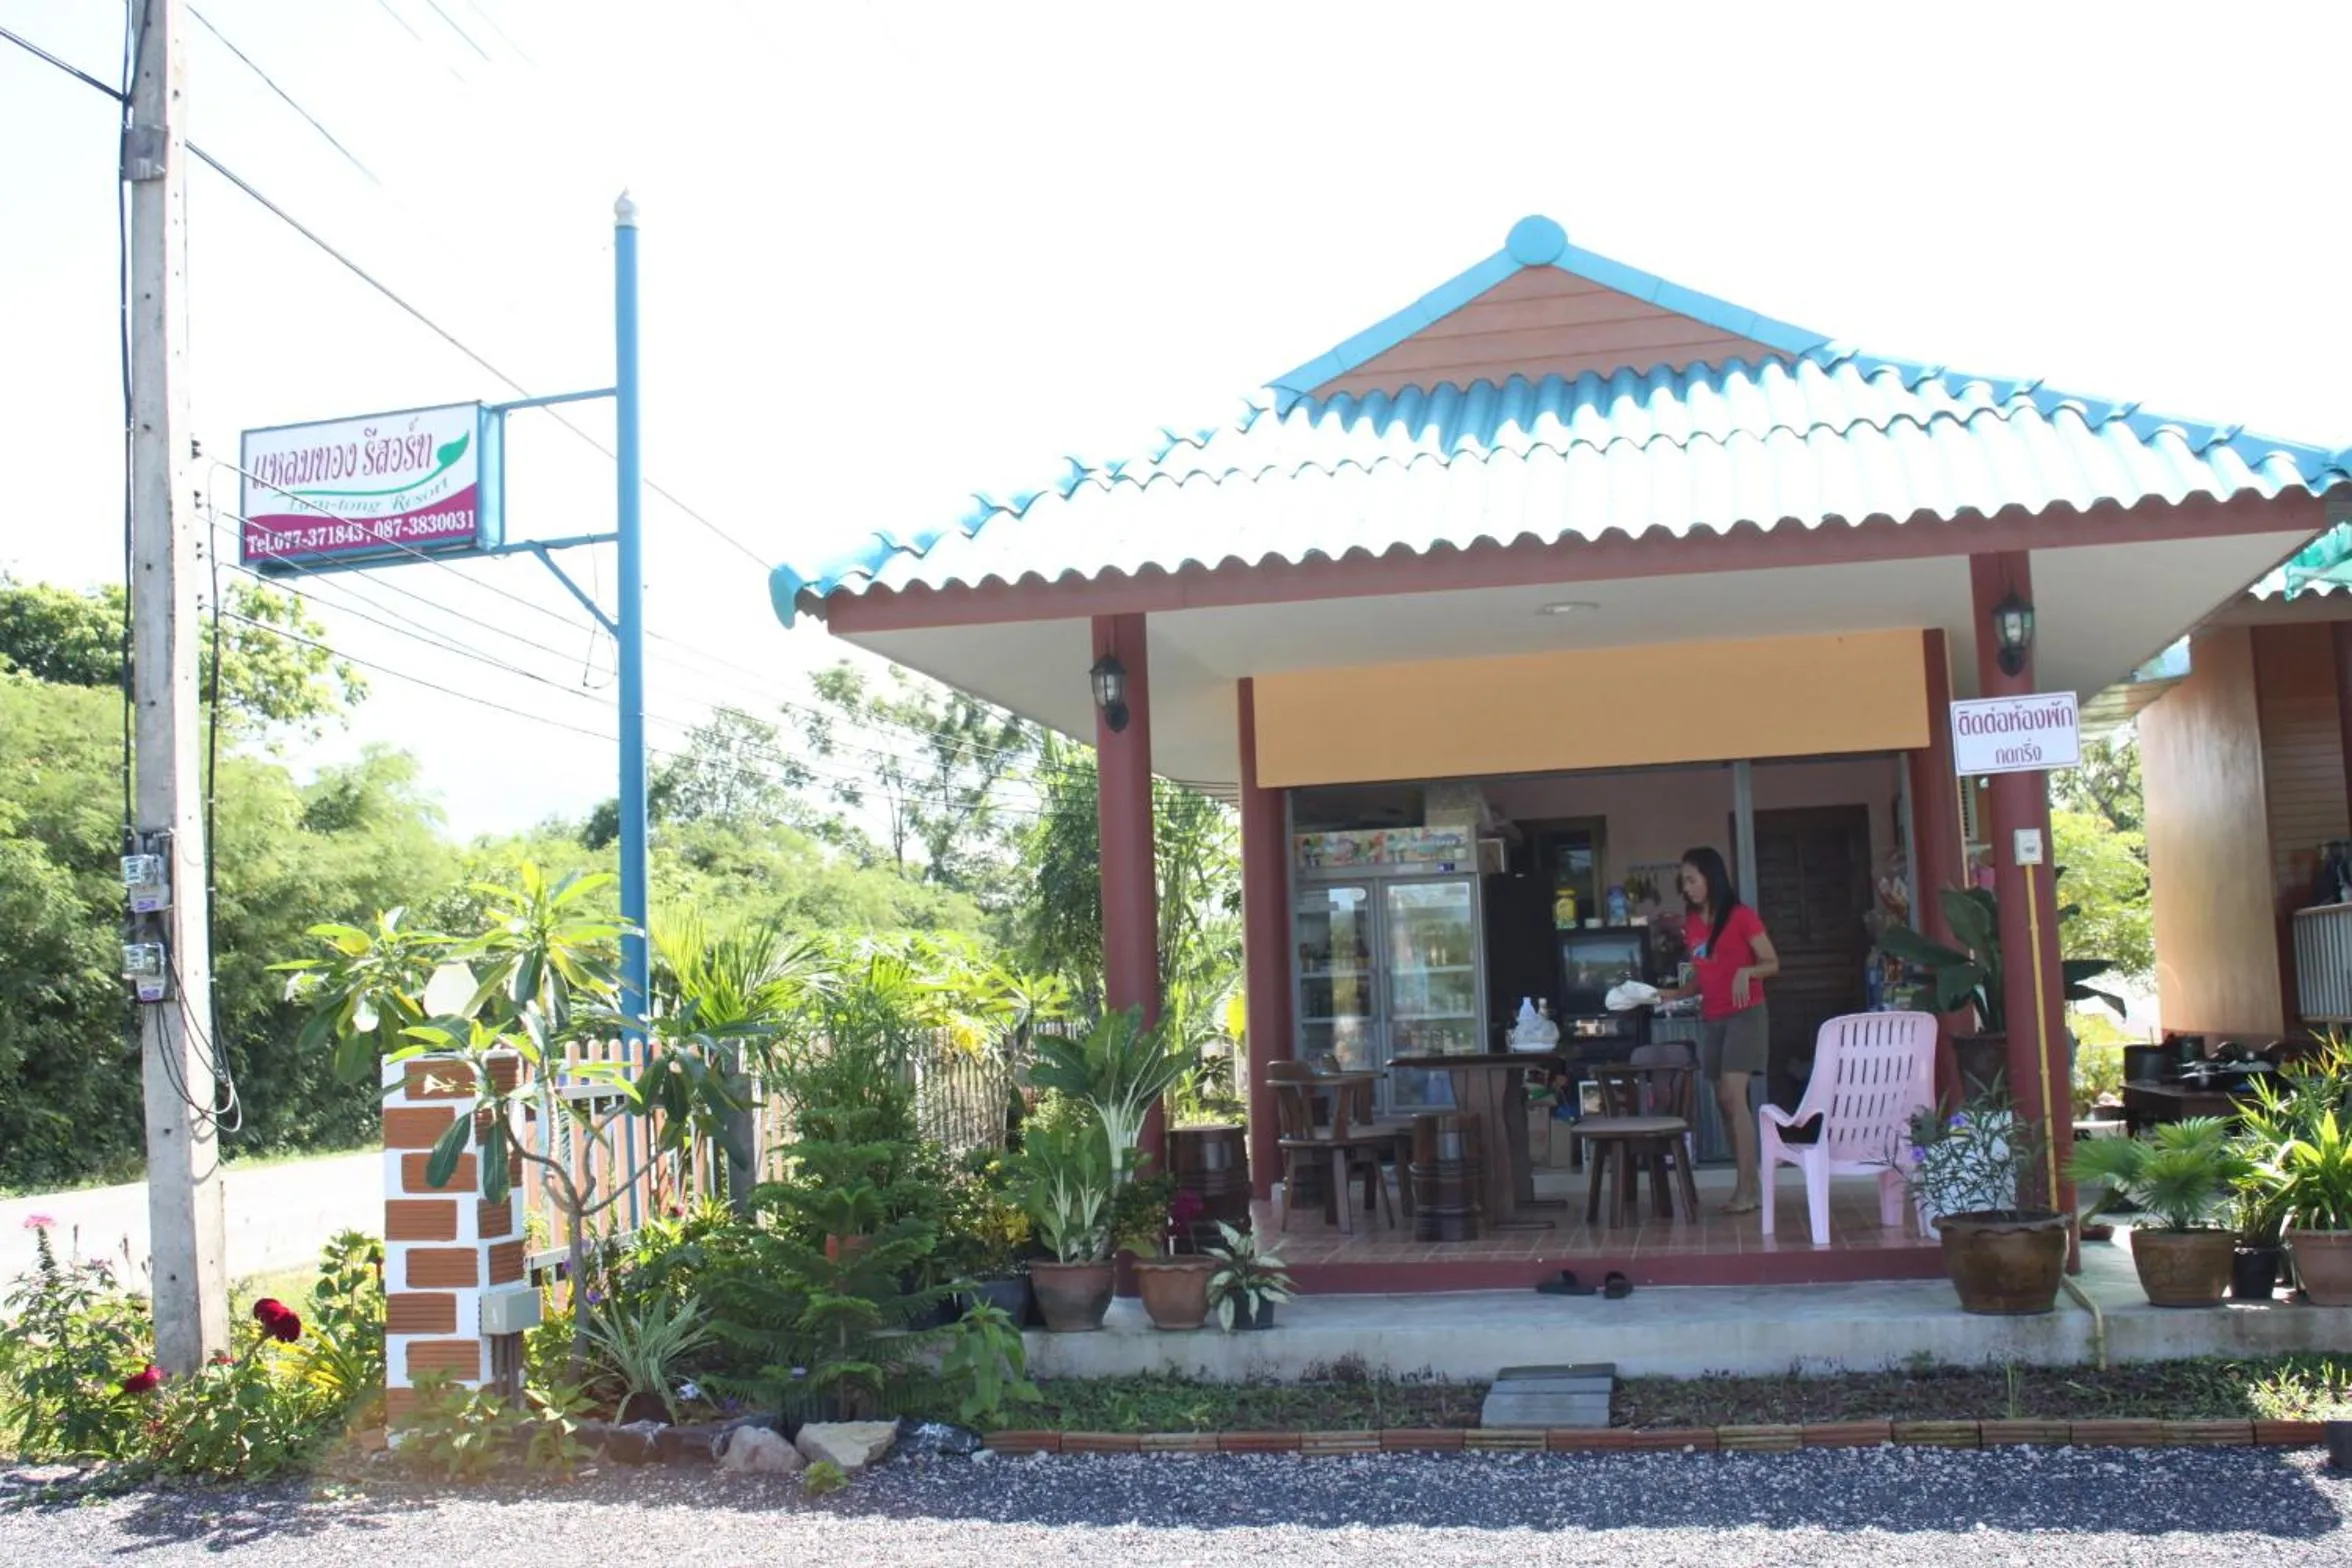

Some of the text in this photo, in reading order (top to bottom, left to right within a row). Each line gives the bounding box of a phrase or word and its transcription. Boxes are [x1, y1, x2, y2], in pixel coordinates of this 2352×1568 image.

[252, 441, 357, 489] แหลมทอง
[373, 510, 475, 539] 087-3830031
[1958, 700, 2073, 735] ติดต่อห้องพัก
